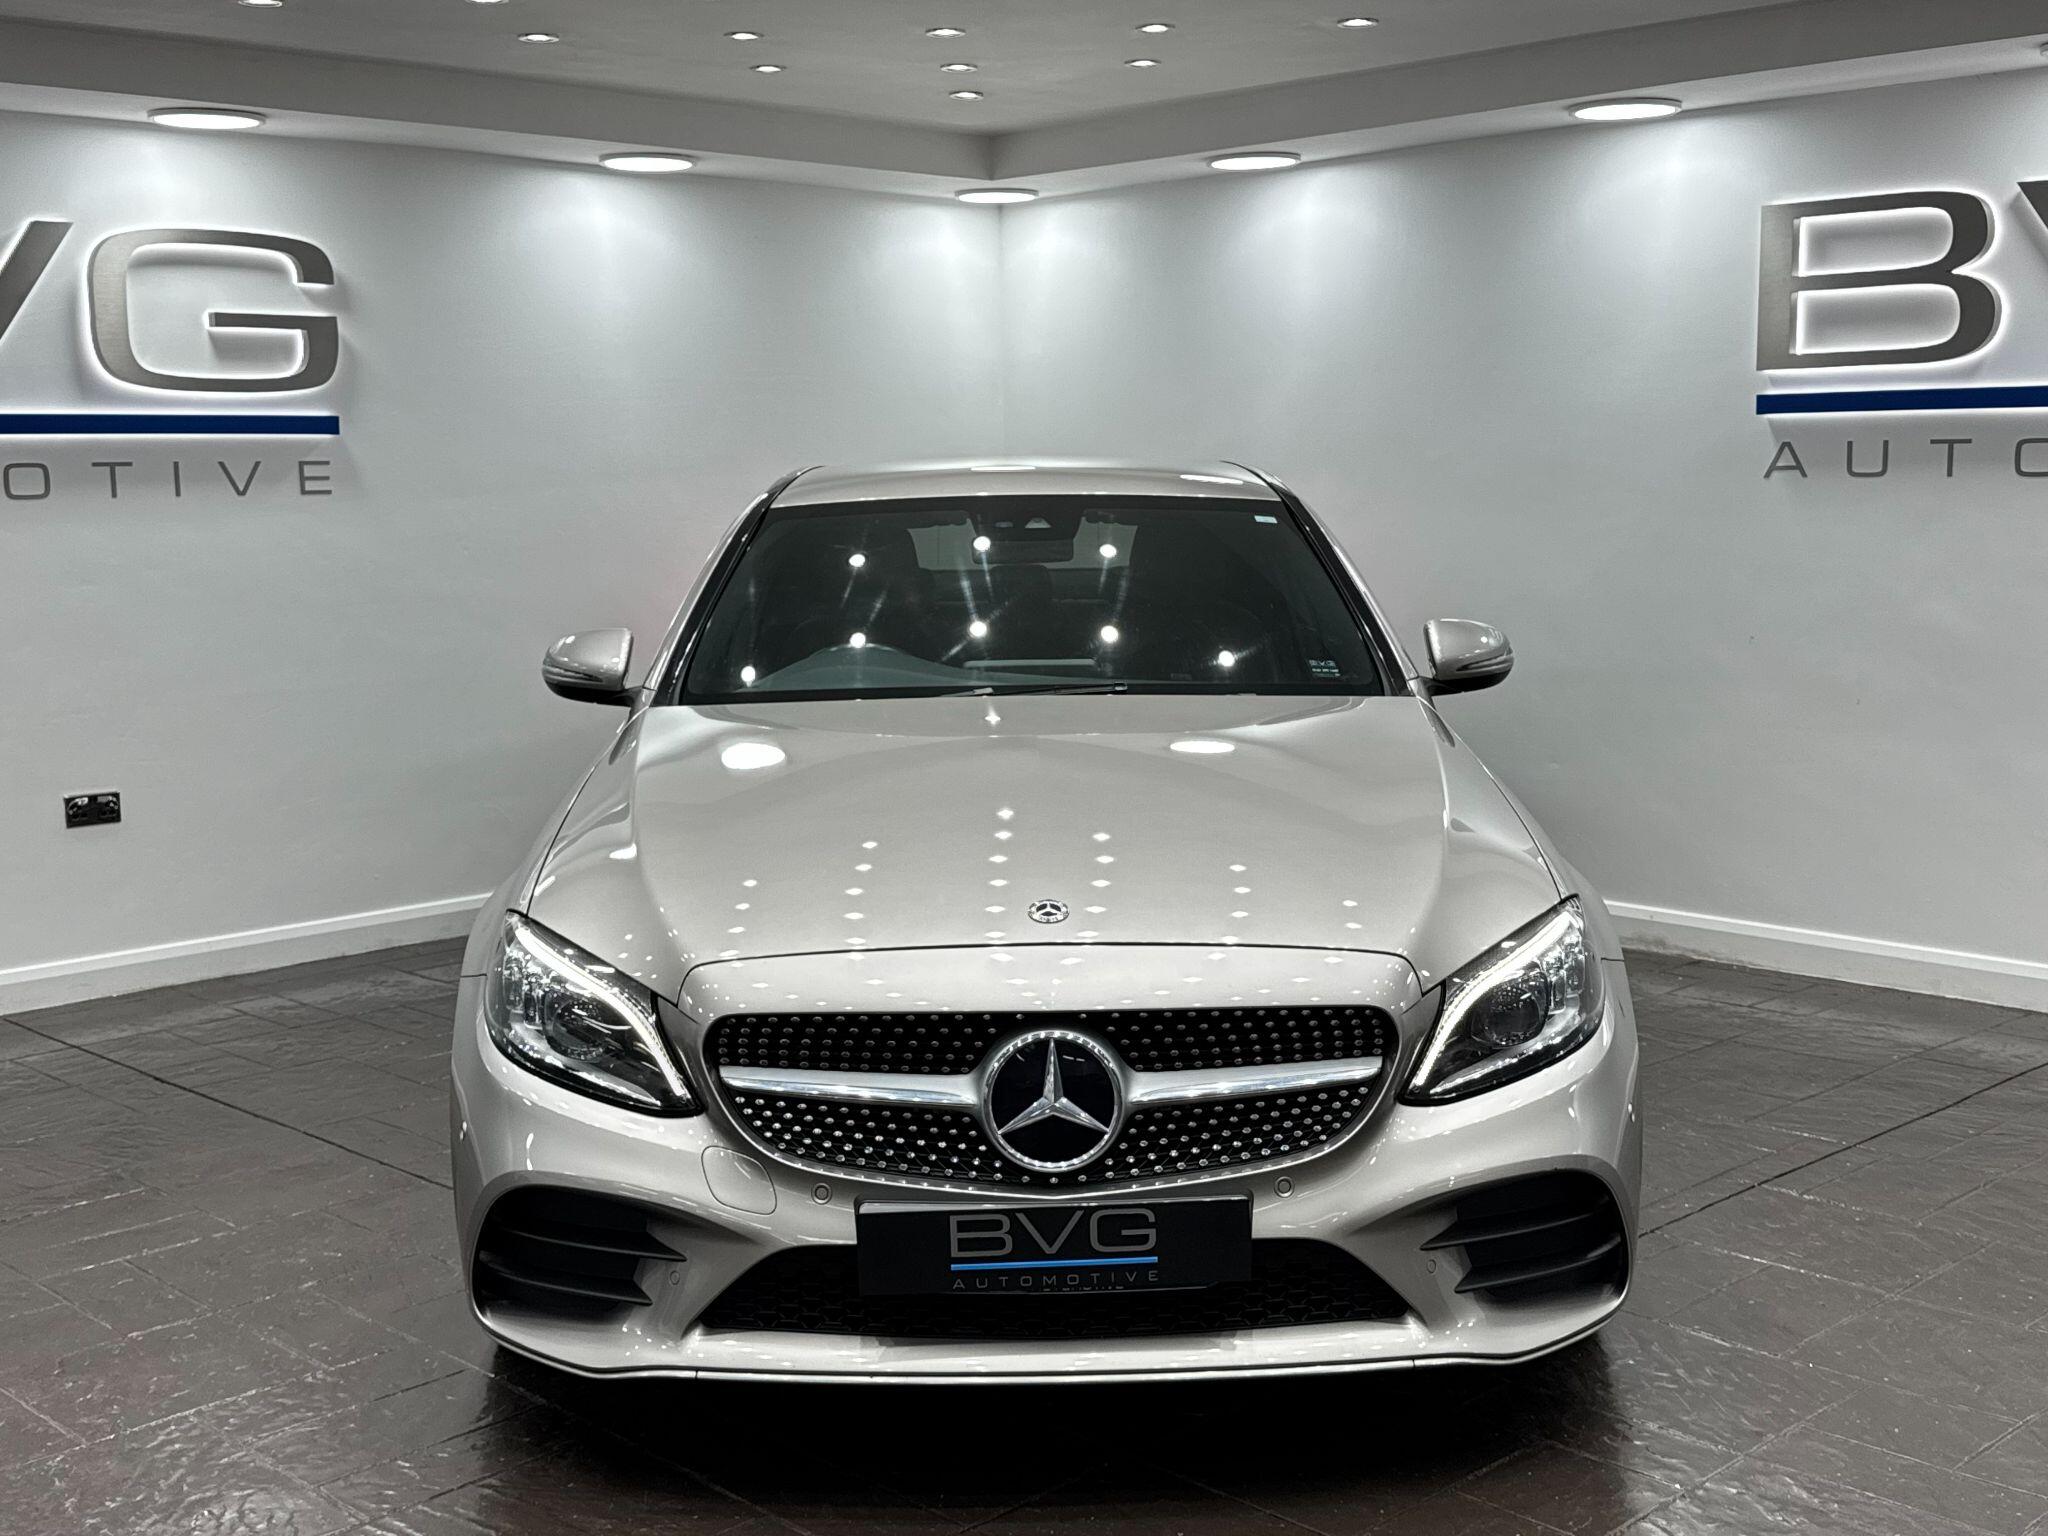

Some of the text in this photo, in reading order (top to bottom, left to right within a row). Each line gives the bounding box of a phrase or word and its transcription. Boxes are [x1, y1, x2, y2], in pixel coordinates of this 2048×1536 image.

[1756, 190, 2048, 371] B
[949, 1208, 1157, 1258] BVG
[952, 1270, 1159, 1289] AUTOMOTIVE
